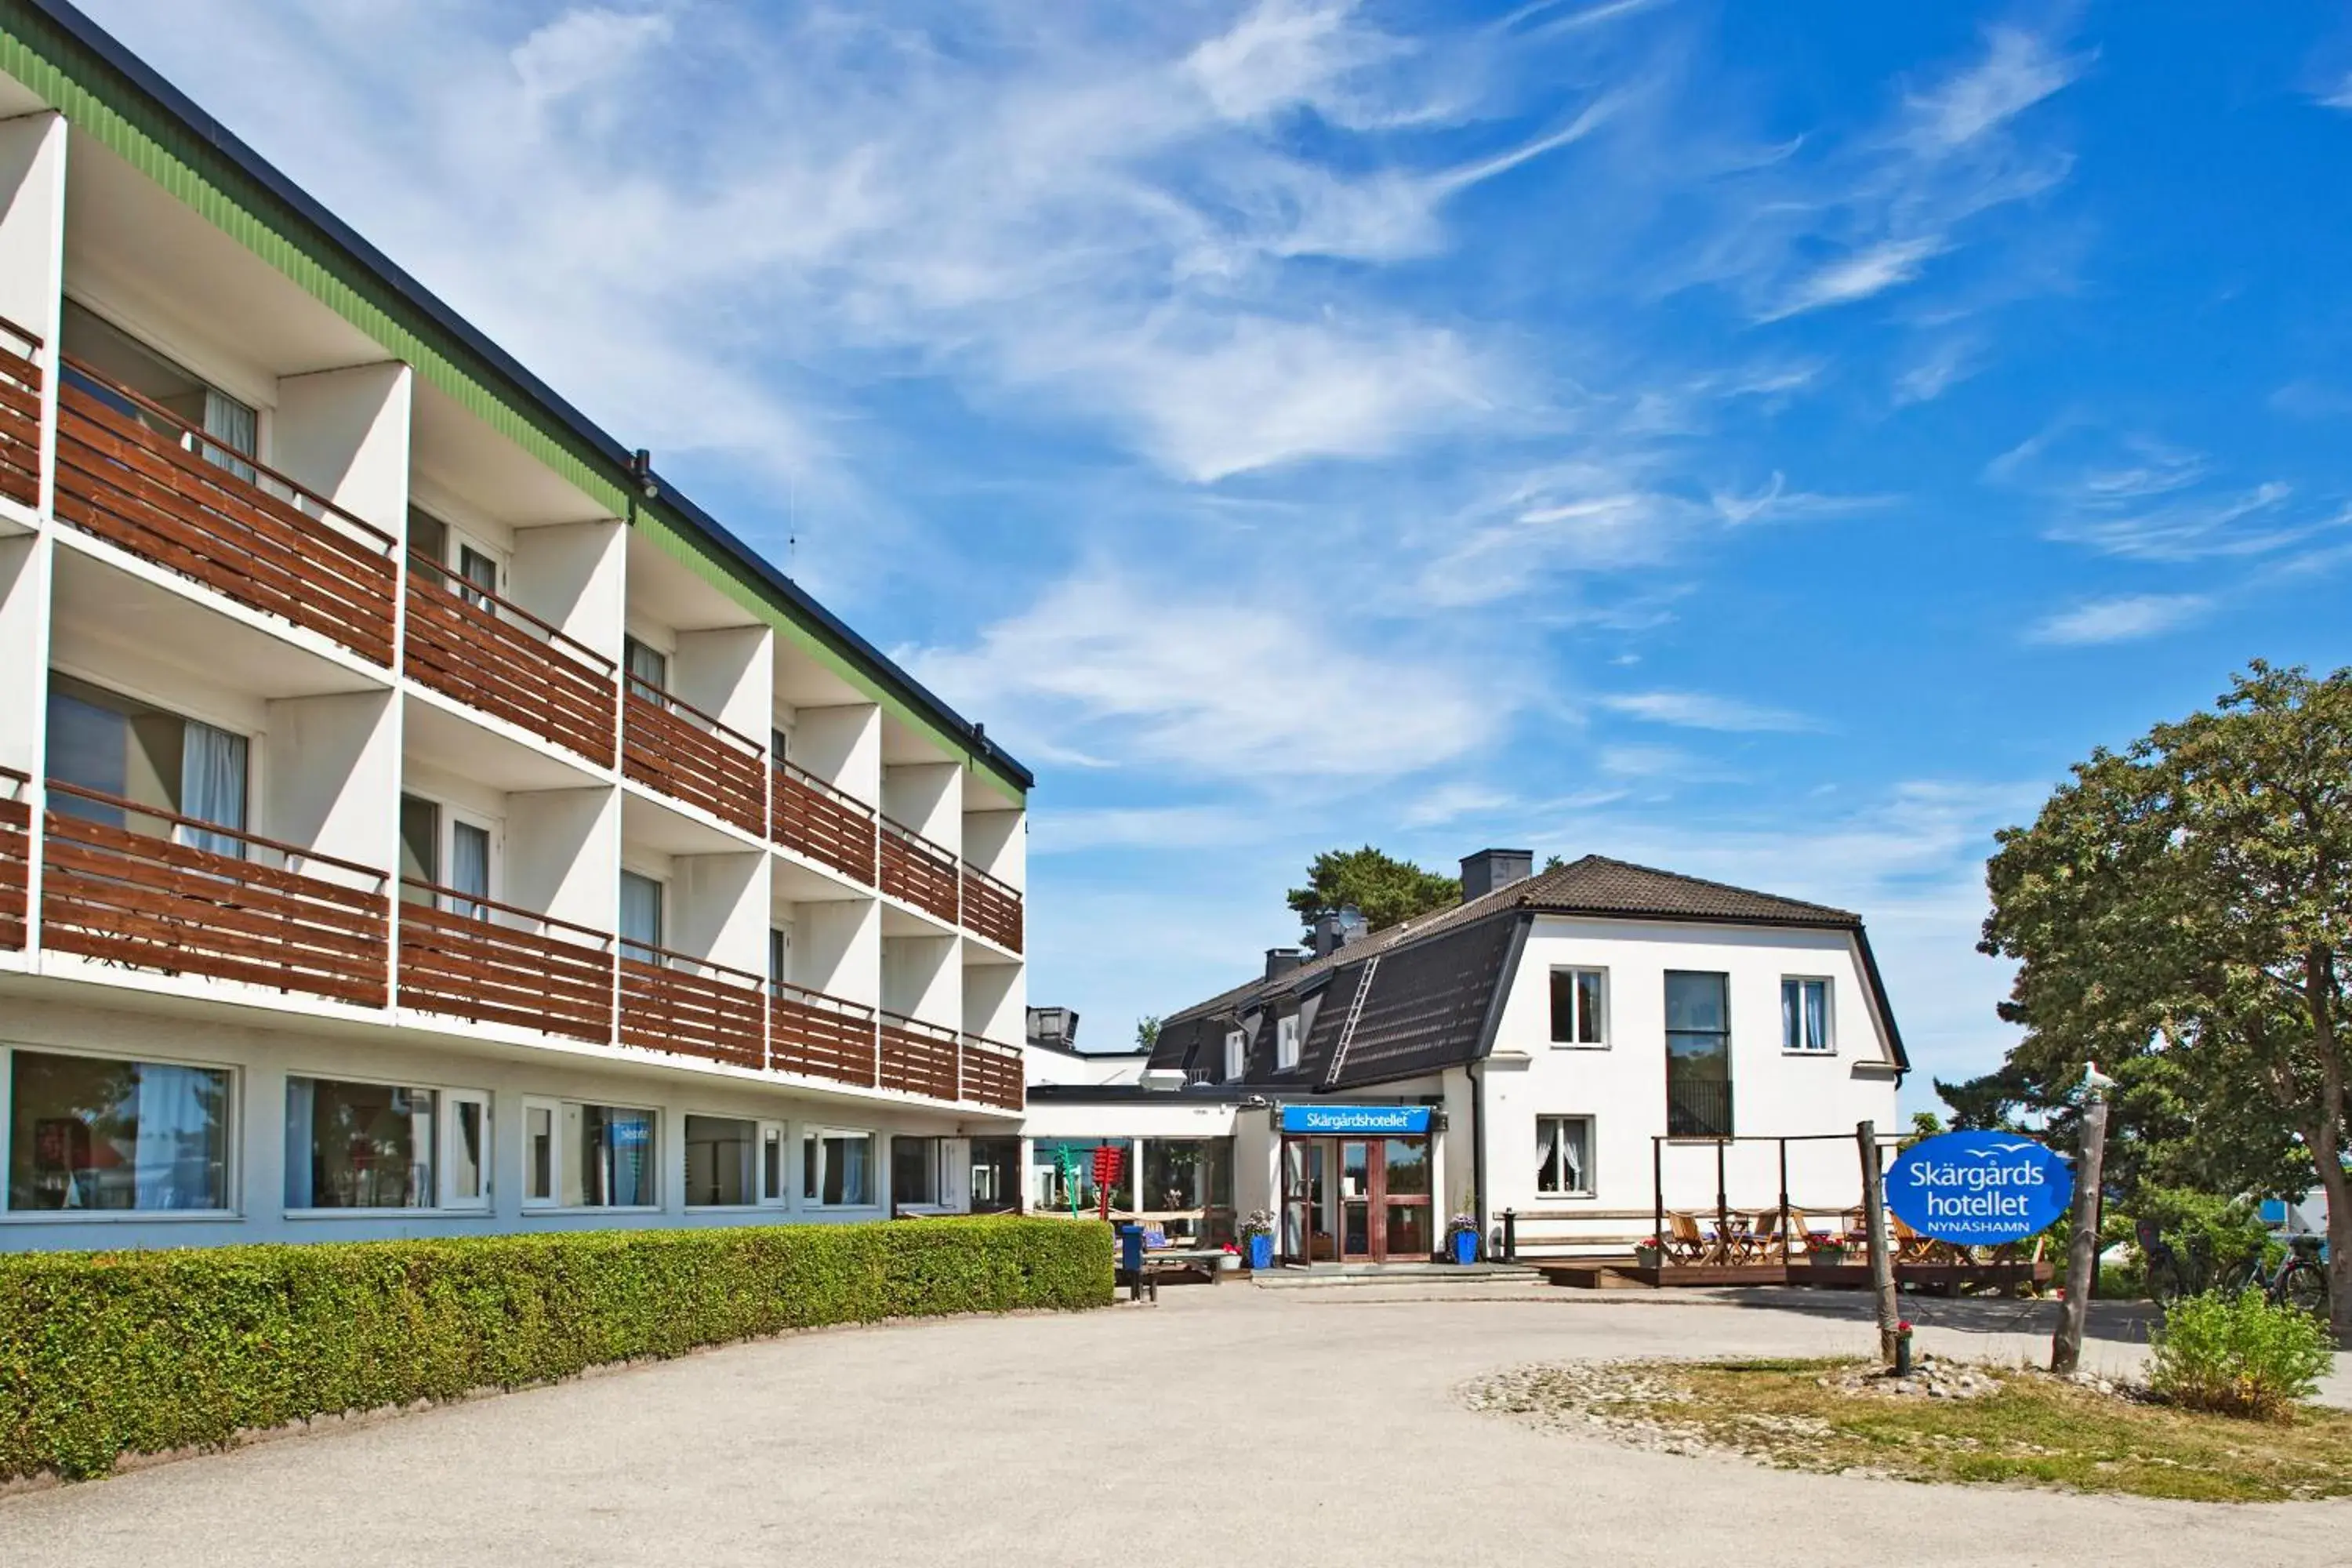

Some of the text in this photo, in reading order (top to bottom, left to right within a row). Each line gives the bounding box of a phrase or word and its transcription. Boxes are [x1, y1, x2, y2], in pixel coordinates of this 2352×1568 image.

[1307, 1112, 1408, 1129] Skärgårdshotellet
[1909, 1160, 2045, 1191] Skärgårds
[1928, 1191, 2029, 1216] hotellet
[1928, 1220, 2030, 1232] NYNÄSHAMN
